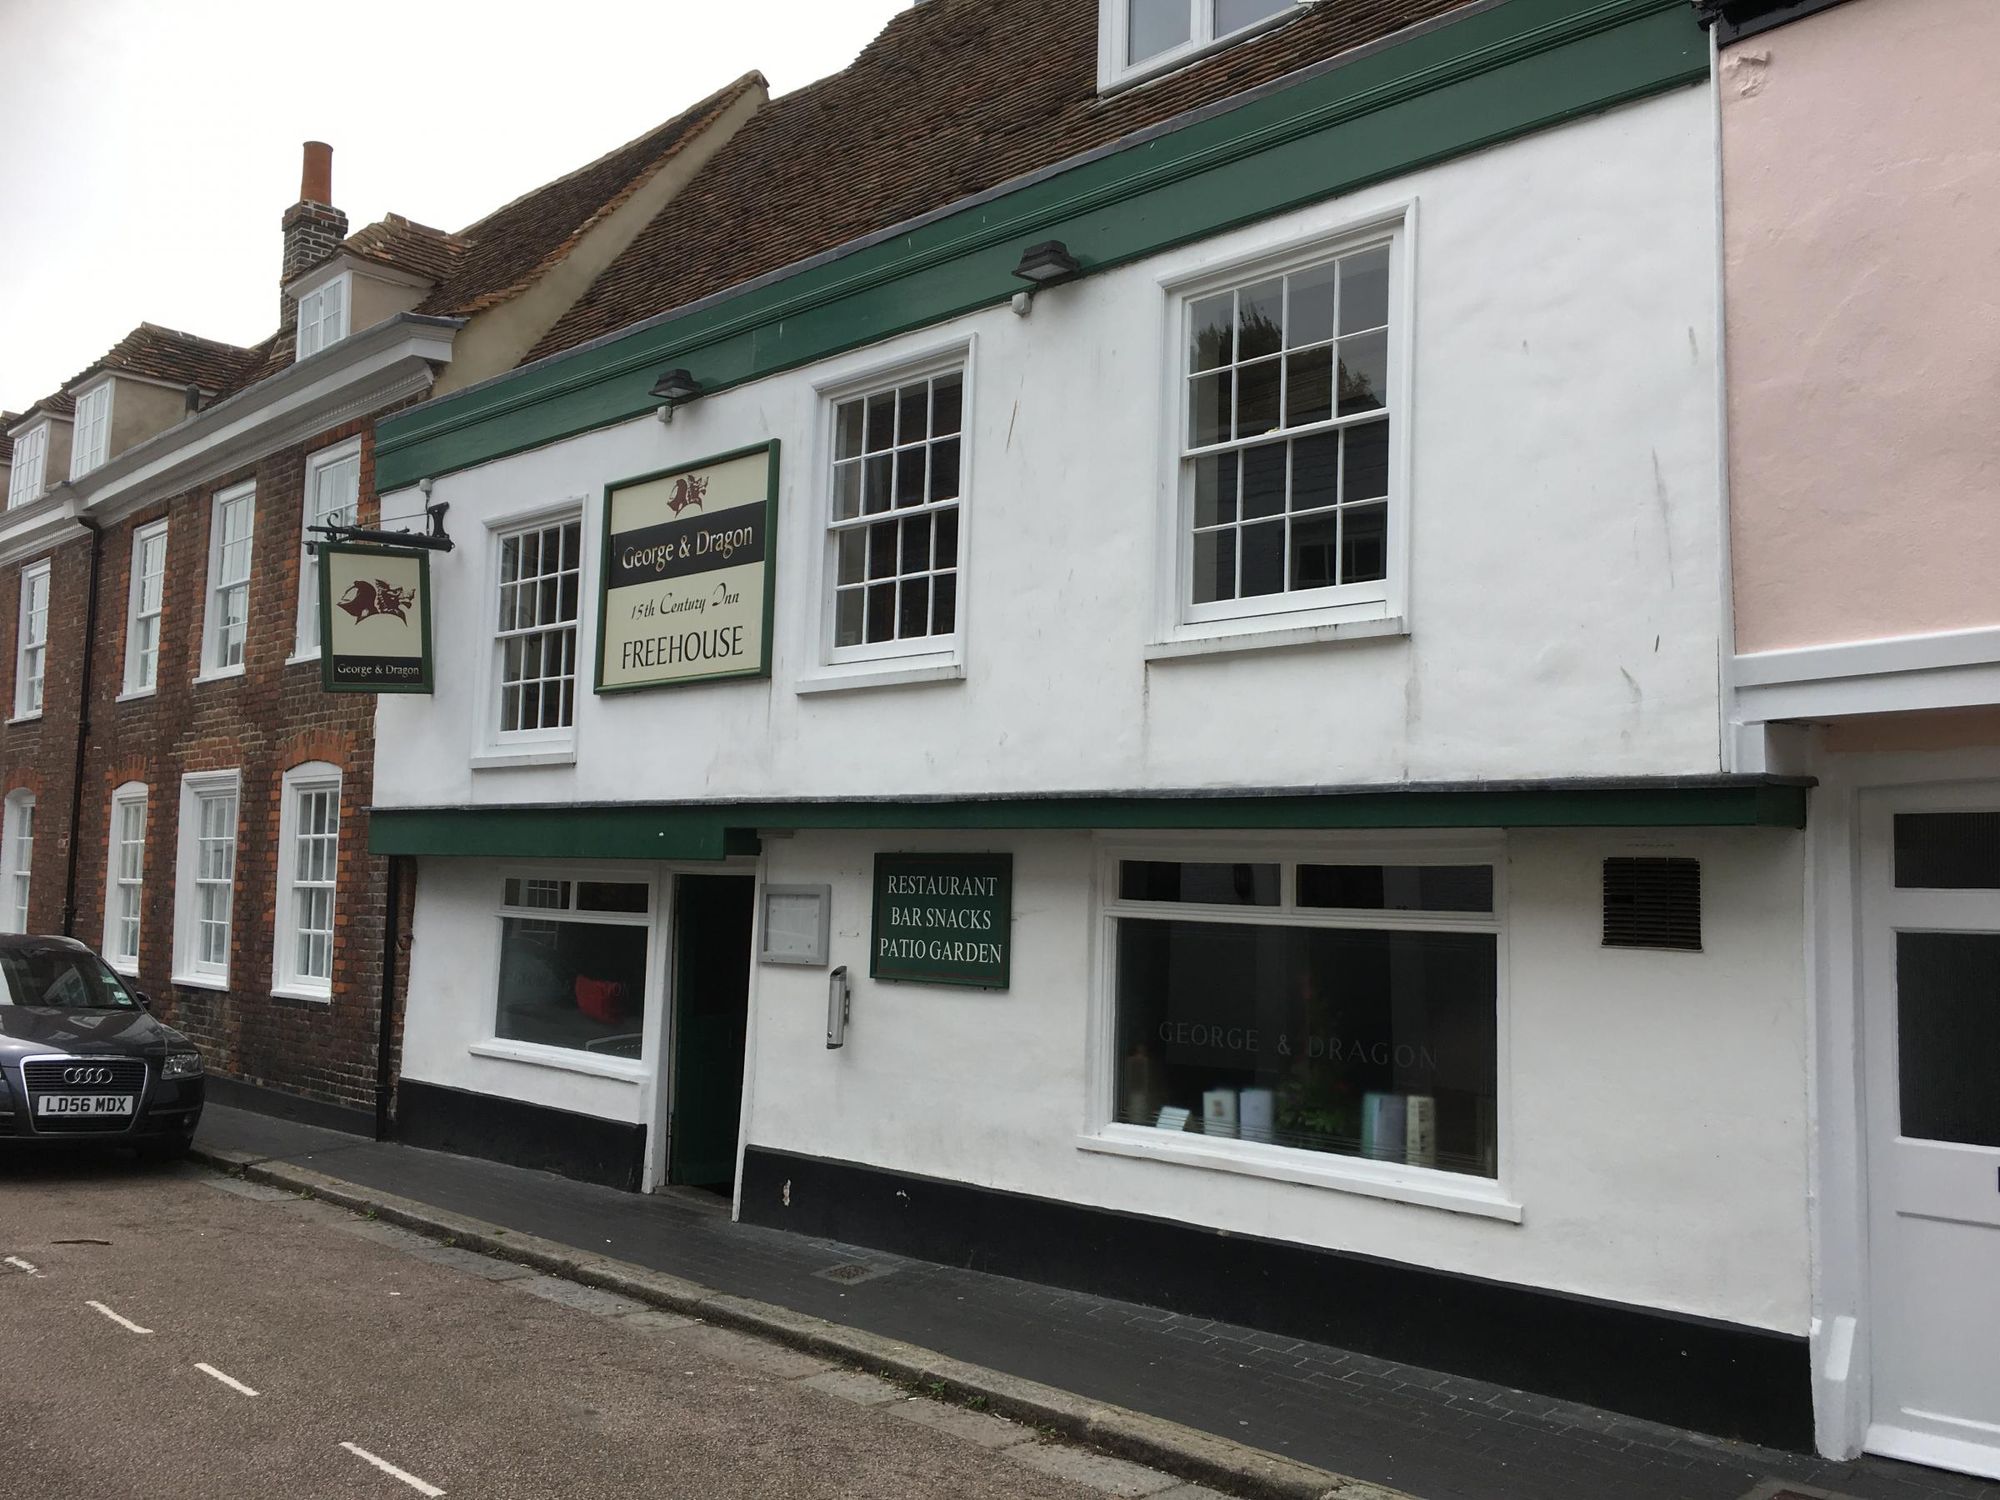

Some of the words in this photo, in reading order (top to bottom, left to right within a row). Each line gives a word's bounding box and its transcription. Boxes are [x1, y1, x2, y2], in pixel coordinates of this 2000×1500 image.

[622, 543, 674, 572] George
[678, 535, 691, 558] &
[696, 526, 753, 559] Dragon
[631, 599, 655, 620] 15th
[660, 592, 706, 614] Century
[712, 582, 740, 606] Inn
[622, 625, 744, 669] FREEHOUSE
[337, 664, 372, 677] George
[374, 664, 383, 674] &
[385, 664, 419, 678] Dragon
[888, 875, 997, 896] RESTAURANT
[891, 907, 922, 927] BAR
[926, 908, 991, 930] SNACKS
[879, 938, 926, 958] PATIO
[929, 941, 1002, 963] GARDEN
[1159, 1022, 1259, 1050] GEORGE
[1278, 1034, 1292, 1056] &
[1308, 1037, 1438, 1071] DRAGON
[46, 1098, 91, 1112] LD56
[94, 1098, 126, 1112] MDX
